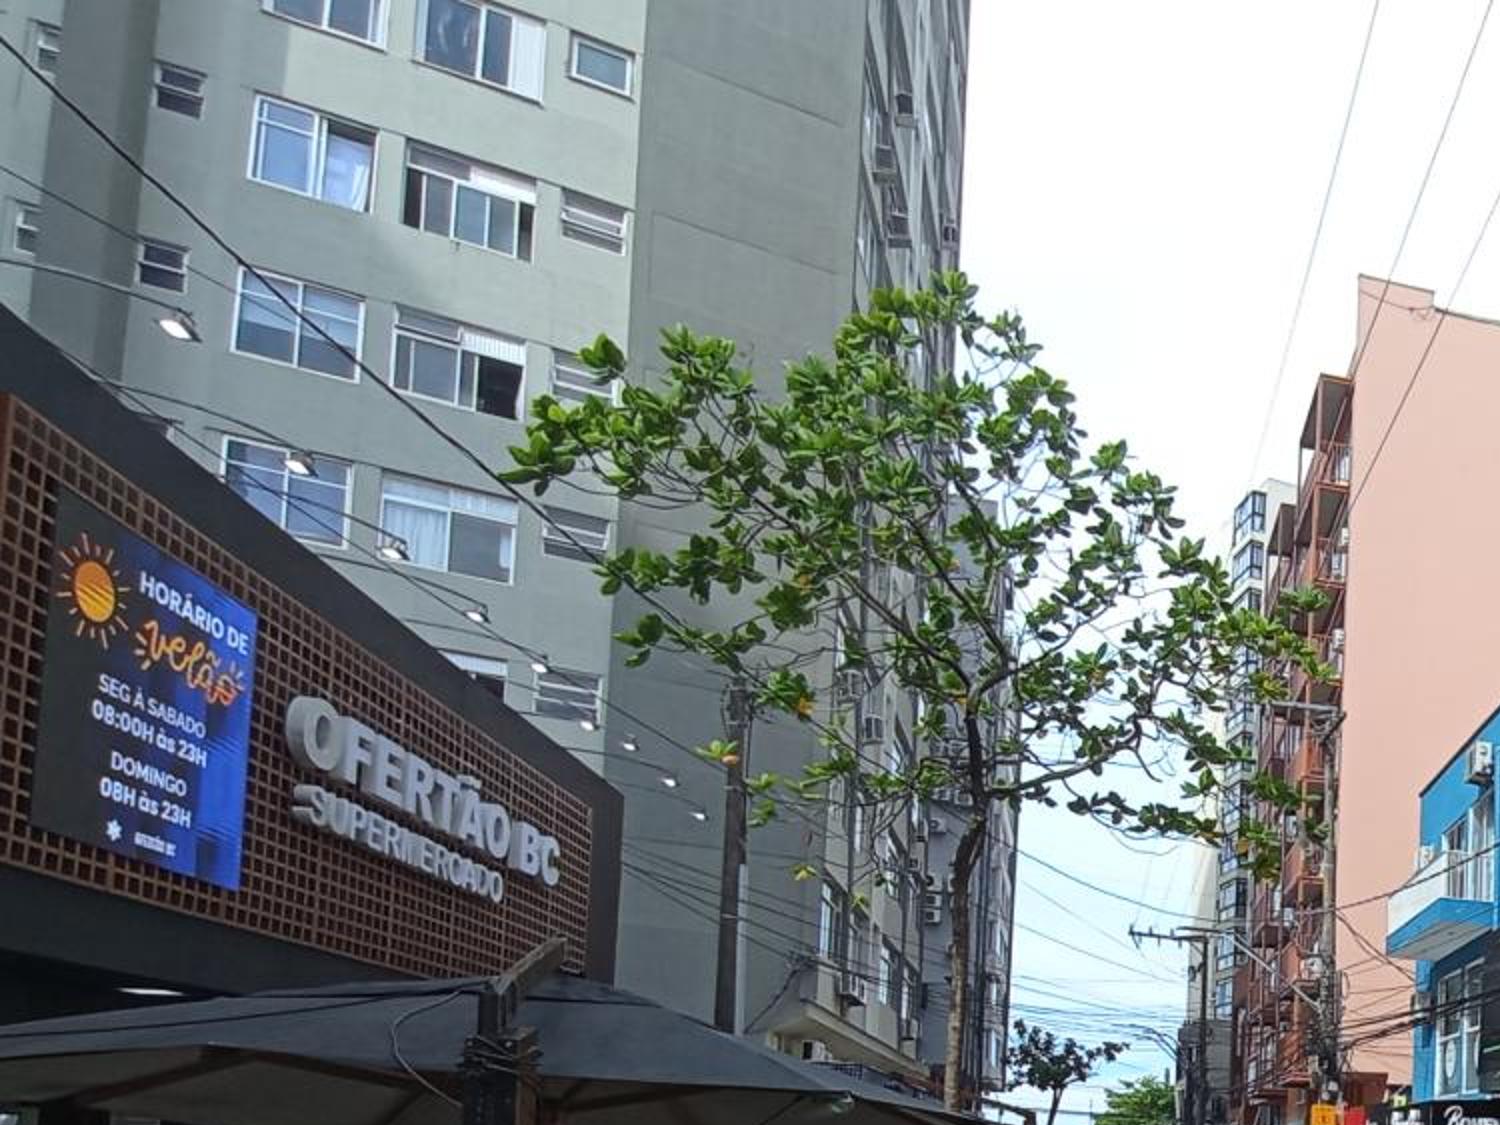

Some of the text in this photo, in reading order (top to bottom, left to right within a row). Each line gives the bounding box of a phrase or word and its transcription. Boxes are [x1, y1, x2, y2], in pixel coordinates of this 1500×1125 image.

[139, 570, 250, 656] HORÁRIO DE
[92, 698, 208, 769] 08:00H às 23H
[98, 673, 207, 740] SEG À SABADO
[99, 776, 193, 830] 08H às 23H
[110, 750, 188, 798] DOMINGO
[285, 695, 562, 887] OFERTÃO BC
[292, 783, 505, 904] SUPERMERCADO
